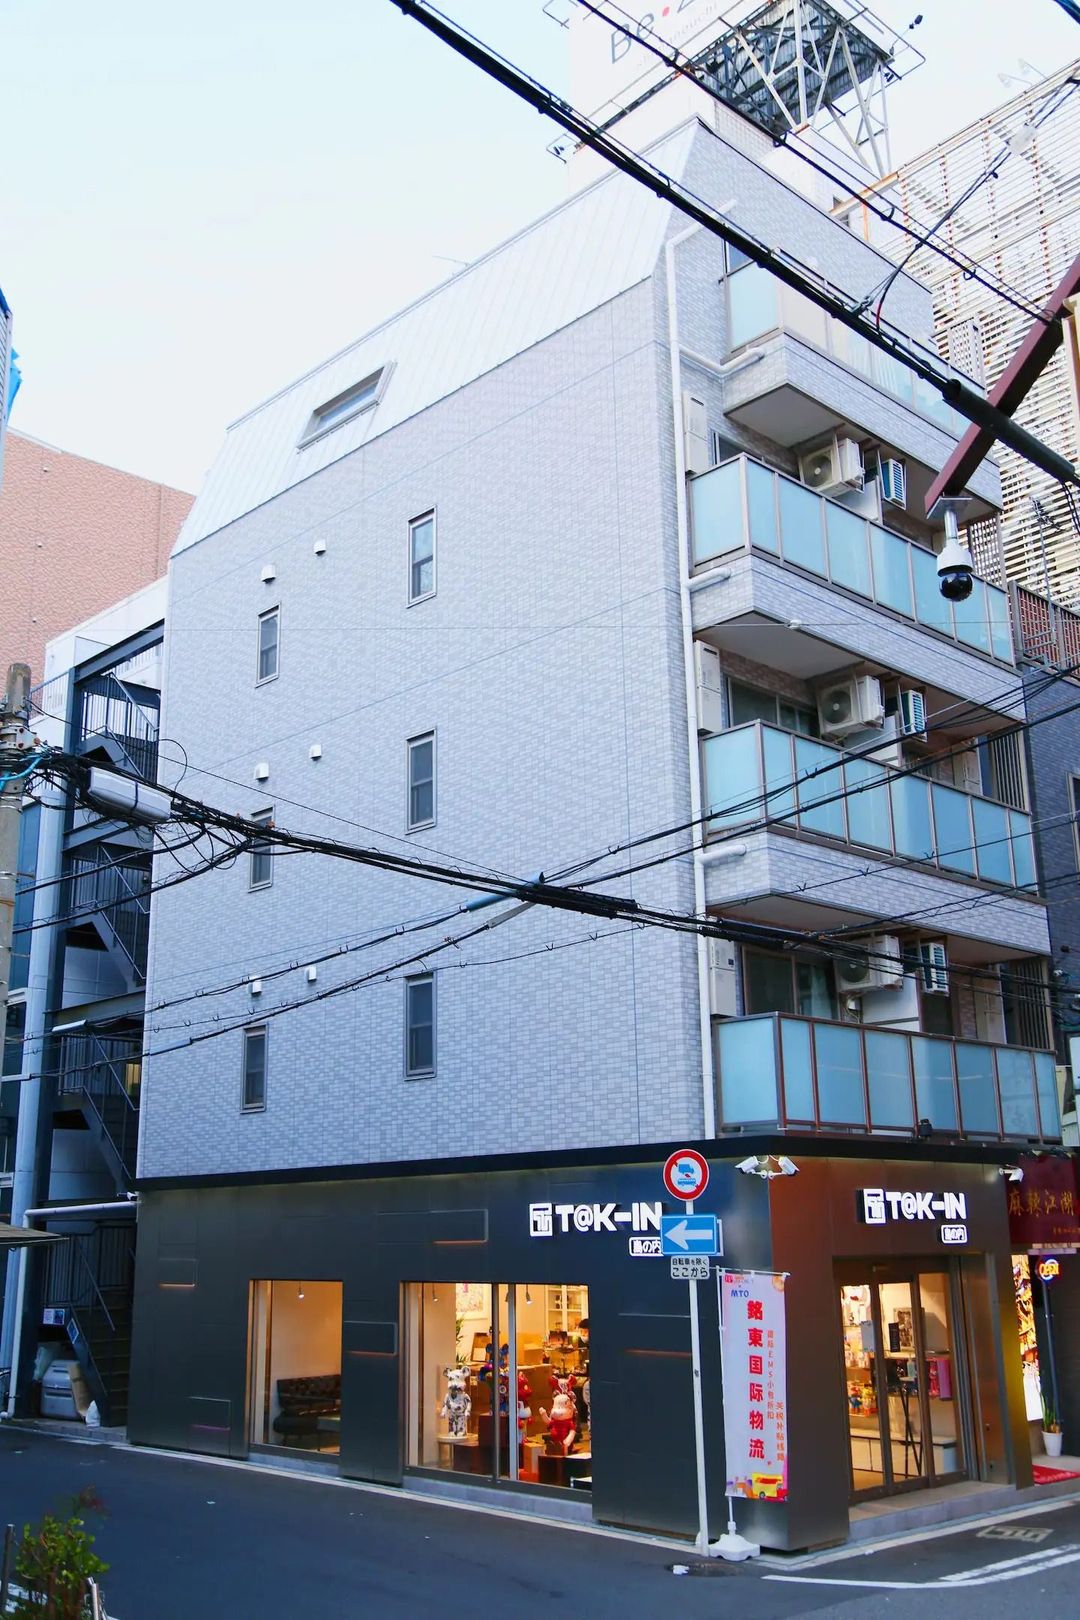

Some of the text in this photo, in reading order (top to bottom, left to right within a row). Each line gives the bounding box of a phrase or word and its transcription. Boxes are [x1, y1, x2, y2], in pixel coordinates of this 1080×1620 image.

[885, 1192, 967, 1220] T@K-IN
[555, 1202, 662, 1232] T@K-IN
[672, 1257, 707, 1266] 自転車を除く
[672, 1267, 708, 1277] ここから
[1038, 1263, 1059, 1275] OPEN
[731, 1290, 749, 1298] MTO
[747, 1300, 764, 1459] 銘東国际物流
